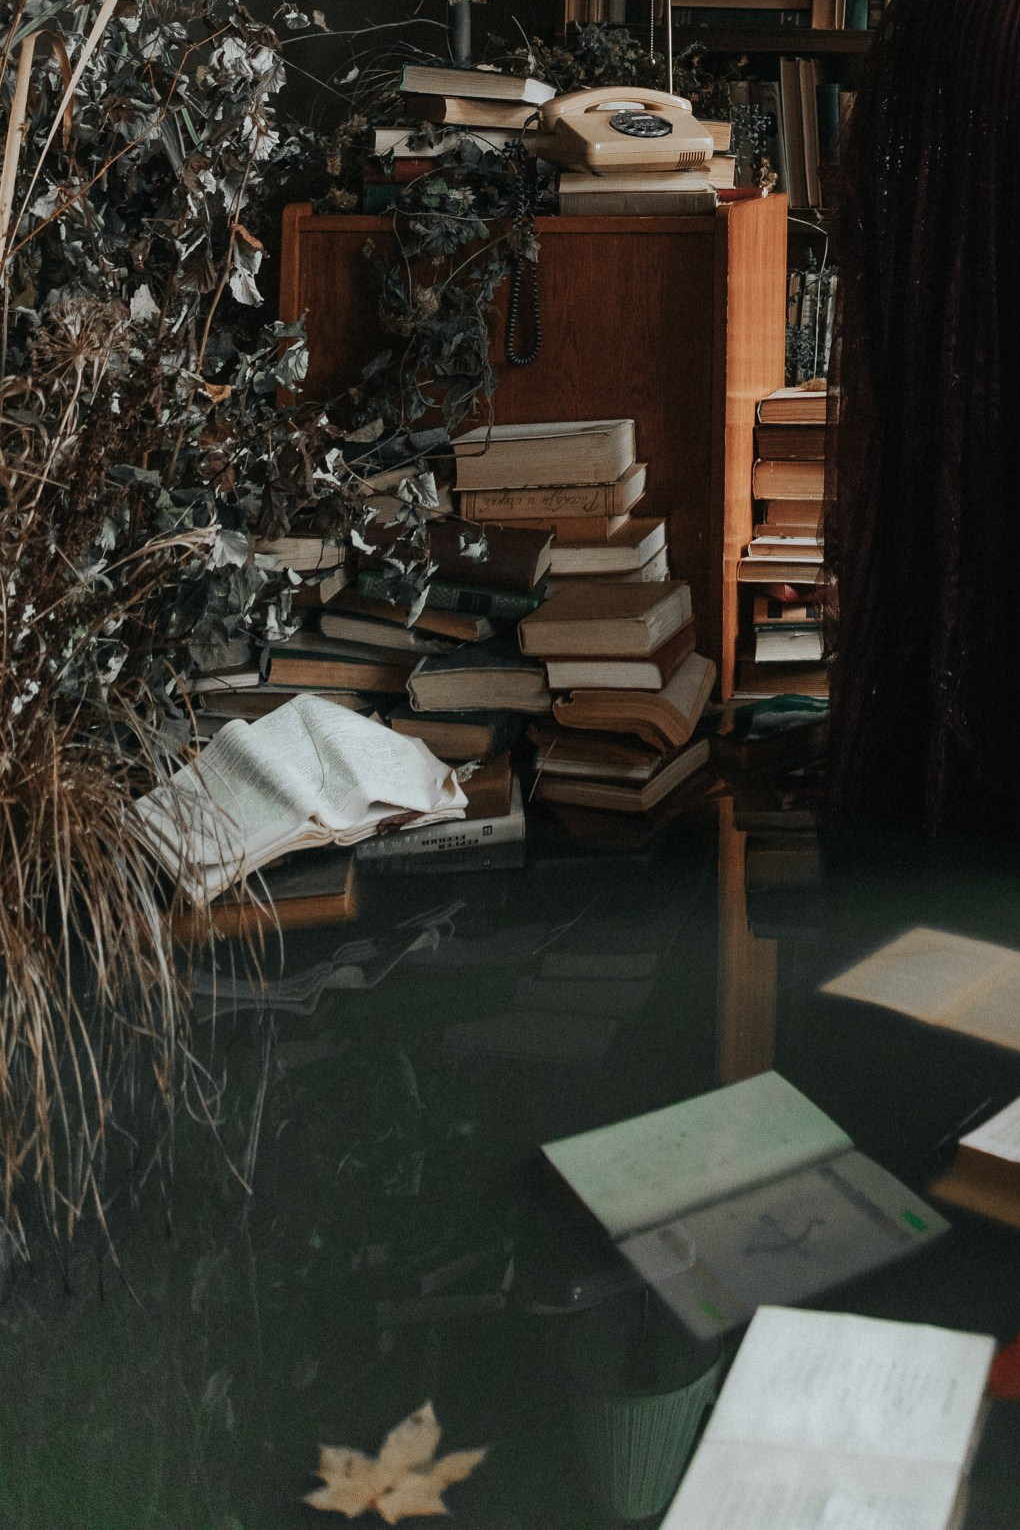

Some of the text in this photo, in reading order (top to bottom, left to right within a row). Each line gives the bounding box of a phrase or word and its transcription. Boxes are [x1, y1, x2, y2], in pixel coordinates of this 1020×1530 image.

[479, 490, 600, 514] Рассказы и очерки
[421, 834, 466, 846] ЕСЕНИН
